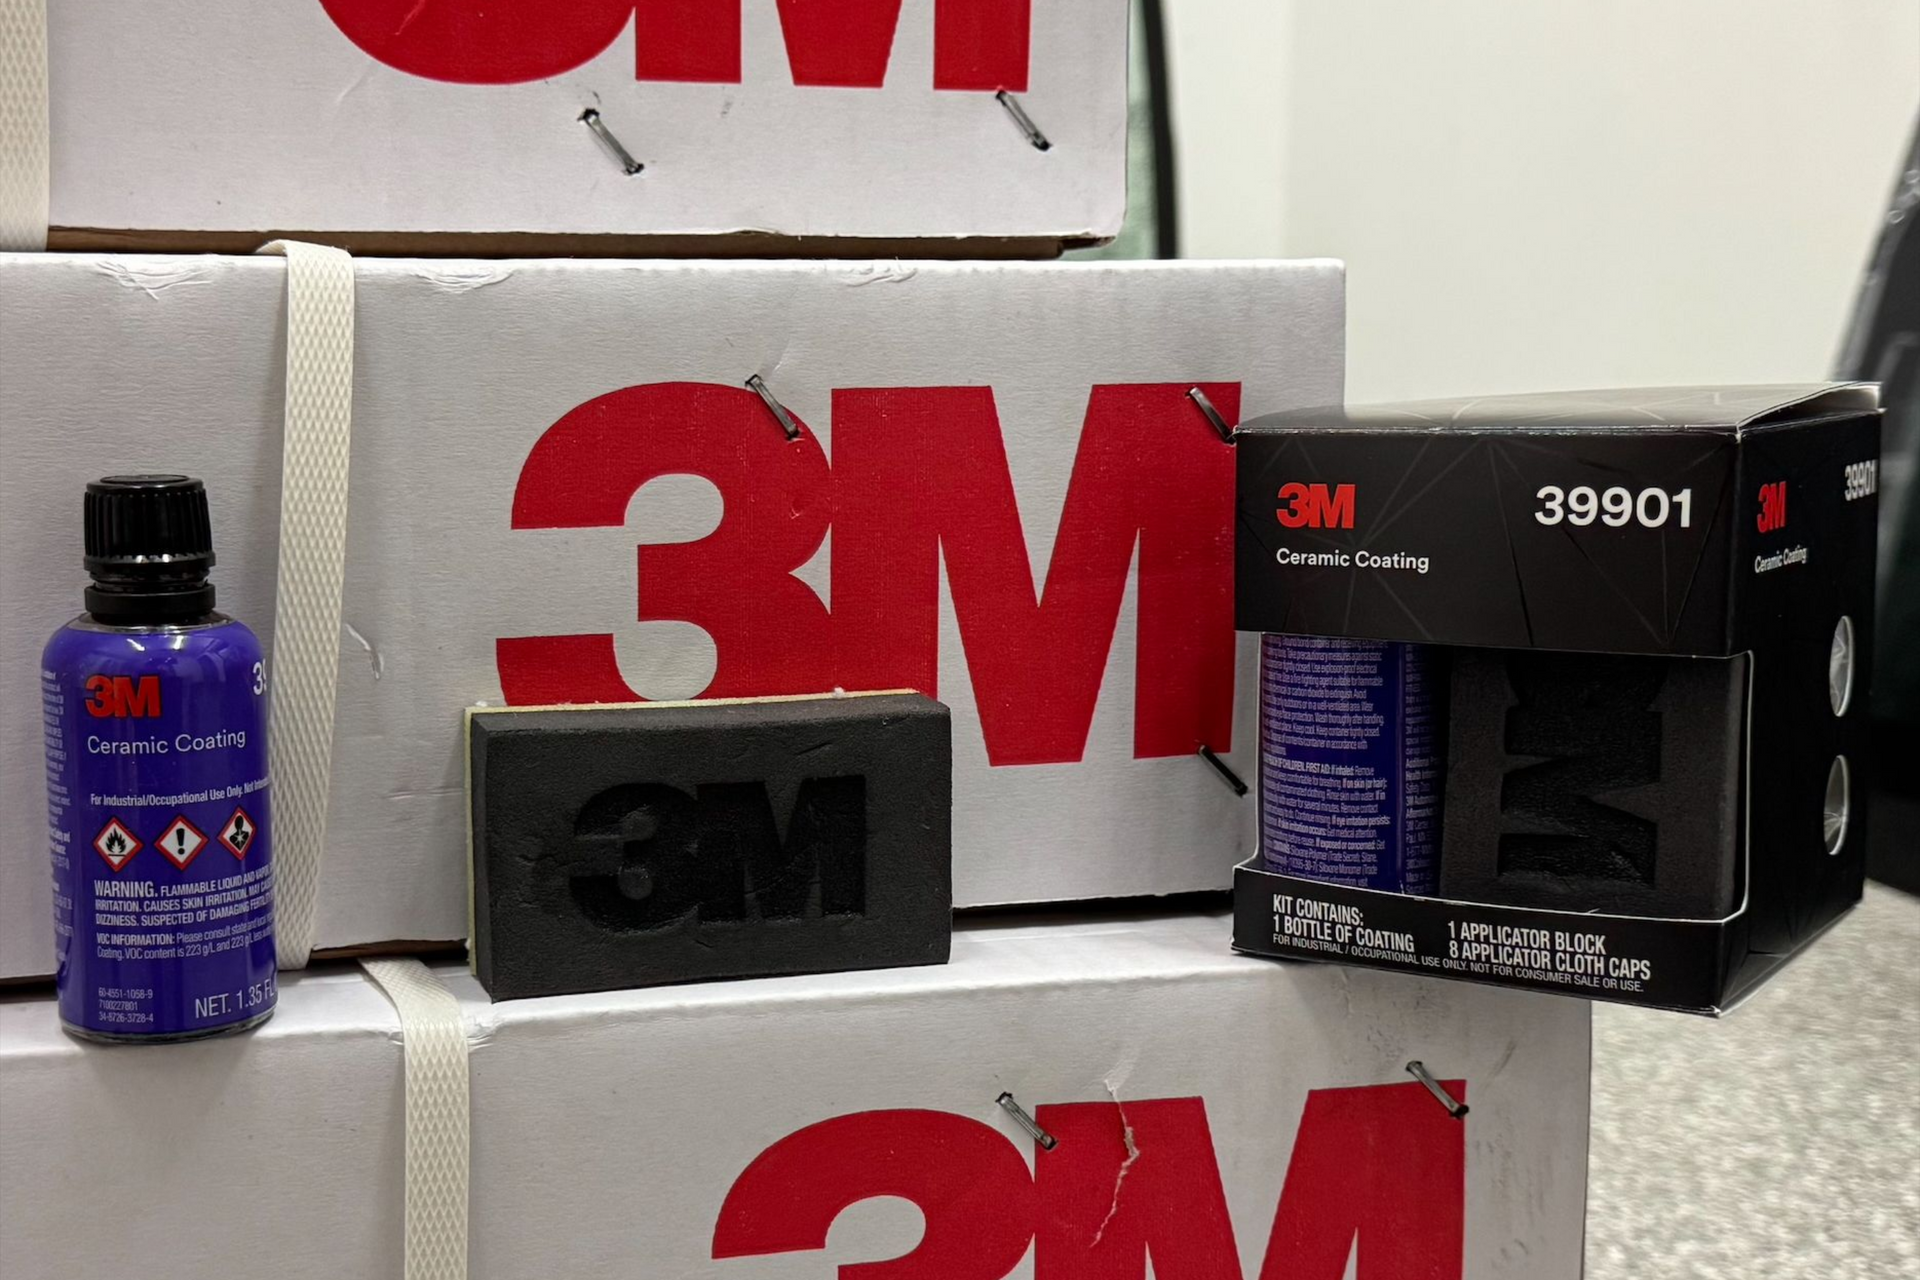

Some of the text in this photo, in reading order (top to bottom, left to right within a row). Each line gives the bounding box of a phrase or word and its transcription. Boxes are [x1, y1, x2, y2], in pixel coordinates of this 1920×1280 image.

[1844, 459, 1878, 501] 39901
[1276, 482, 1356, 528] 3M
[1534, 485, 1692, 529] 39901
[1757, 481, 1786, 533] 3M
[496, 381, 1241, 766] 3M
[1276, 547, 1429, 574] Ceramic Coating
[1755, 545, 1807, 573] Ceramic Coating
[85, 674, 162, 719] 3M
[87, 729, 246, 754] Ceramic Coating
[91, 793, 102, 806] For
[103, 790, 208, 807] Industrial/Occupational
[210, 787, 225, 799] Use
[569, 774, 867, 937] 3M
[94, 879, 158, 898] WARNING.
[160, 880, 216, 898] FLAMMABLE
[217, 874, 242, 891] LIQUID
[95, 898, 142, 912] IRRITATION.
[143, 898, 181, 912] CAUSES
[182, 893, 204, 910] SKIN
[205, 885, 247, 907] IRRITATION.
[96, 913, 139, 926] DIZZINESS.
[141, 912, 194, 926] SUSPECTED
[196, 909, 208, 922] OF
[209, 901, 249, 921] DAMAGING
[1273, 893, 1363, 926] KIT CONTAINS:
[96, 932, 110, 945] VOC
[111, 933, 175, 946] INFORMATION:
[176, 929, 203, 944] Please
[204, 925, 231, 940] consult
[125, 946, 143, 959] VOC
[144, 946, 175, 959] content
[177, 946, 185, 958] is
[185, 942, 202, 956] 223
[216, 938, 230, 953] and
[231, 935, 244, 949] 223
[1273, 914, 1414, 954] 1 BOTTLE OF COATING
[1447, 920, 1606, 955] 1 APPLICATOR BLOCK
[1273, 934, 1291, 947] FOR
[1292, 937, 1343, 955] INDUSTRIAL
[1351, 946, 1420, 966] OCCUPATIONAL
[1422, 955, 1441, 968] USE
[1469, 961, 1491, 974] NOT
[1492, 964, 1514, 977] FOR
[1514, 967, 1572, 985] CONSUMER
[1573, 974, 1600, 988] SALE
[1602, 977, 1618, 989] OR
[1618, 980, 1645, 993] USE.
[1449, 940, 1651, 980] 8 APPLICATOR CLOTH CAPS
[195, 992, 232, 1019] NET.
[236, 980, 262, 1010] 1.35
